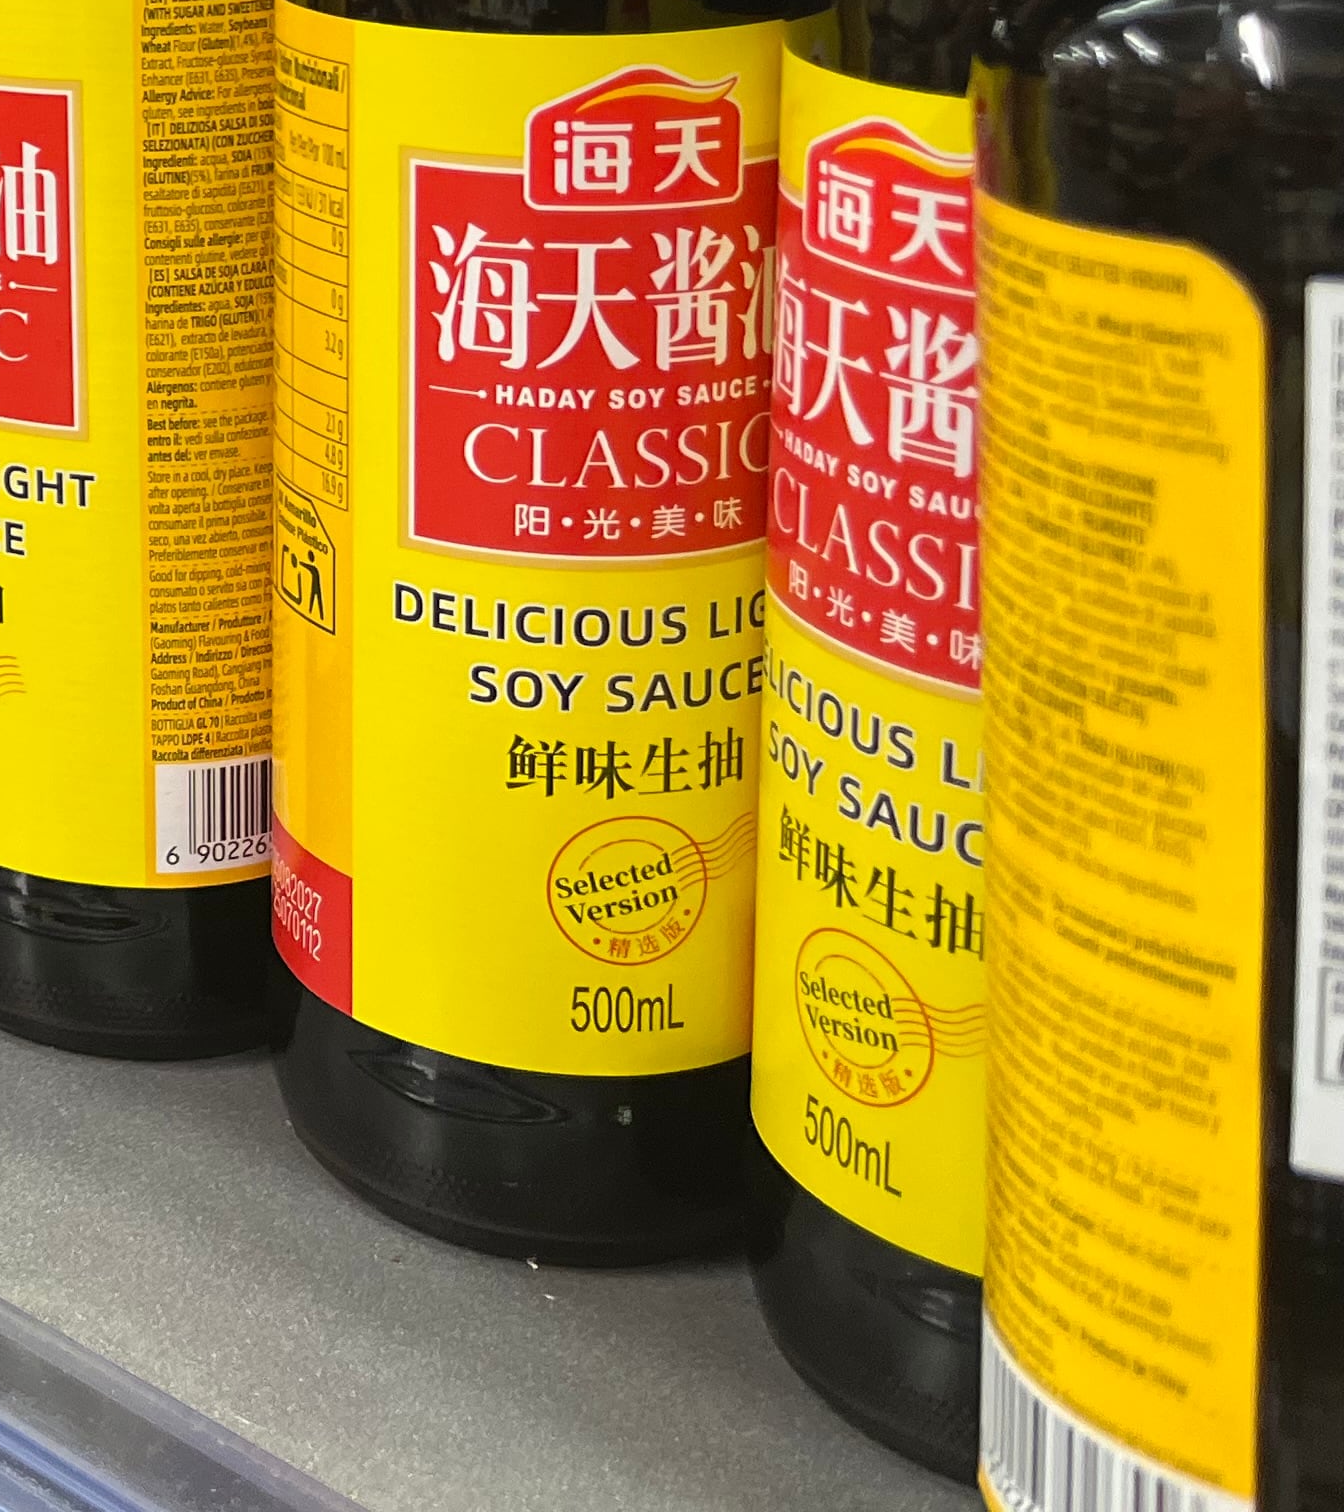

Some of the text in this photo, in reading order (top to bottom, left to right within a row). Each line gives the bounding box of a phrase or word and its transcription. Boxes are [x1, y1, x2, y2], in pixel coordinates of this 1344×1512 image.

[554, 116, 722, 196] 海天
[817, 160, 968, 277] 海天
[495, 377, 757, 411] HADAY SOY SAUCE
[785, 433, 898, 500] HADAY SOY
[393, 581, 688, 648] DELICIOUS
[469, 654, 765, 713] SOY SAUCE
[151, 732, 204, 747] TAPPO LDPE
[505, 726, 745, 801] 鲜味生抽
[768, 718, 824, 797] SOY
[166, 847, 181, 866] 6
[554, 853, 674, 900] Selected
[778, 803, 986, 962] 鲜味生抽
[565, 882, 679, 926] Version
[607, 916, 686, 959] 精选版
[570, 983, 685, 1034] 500mL
[799, 970, 894, 1022] Selected
[804, 1000, 900, 1054] Version
[830, 1060, 909, 1102] 精选版
[804, 1093, 903, 1199] 500mL
